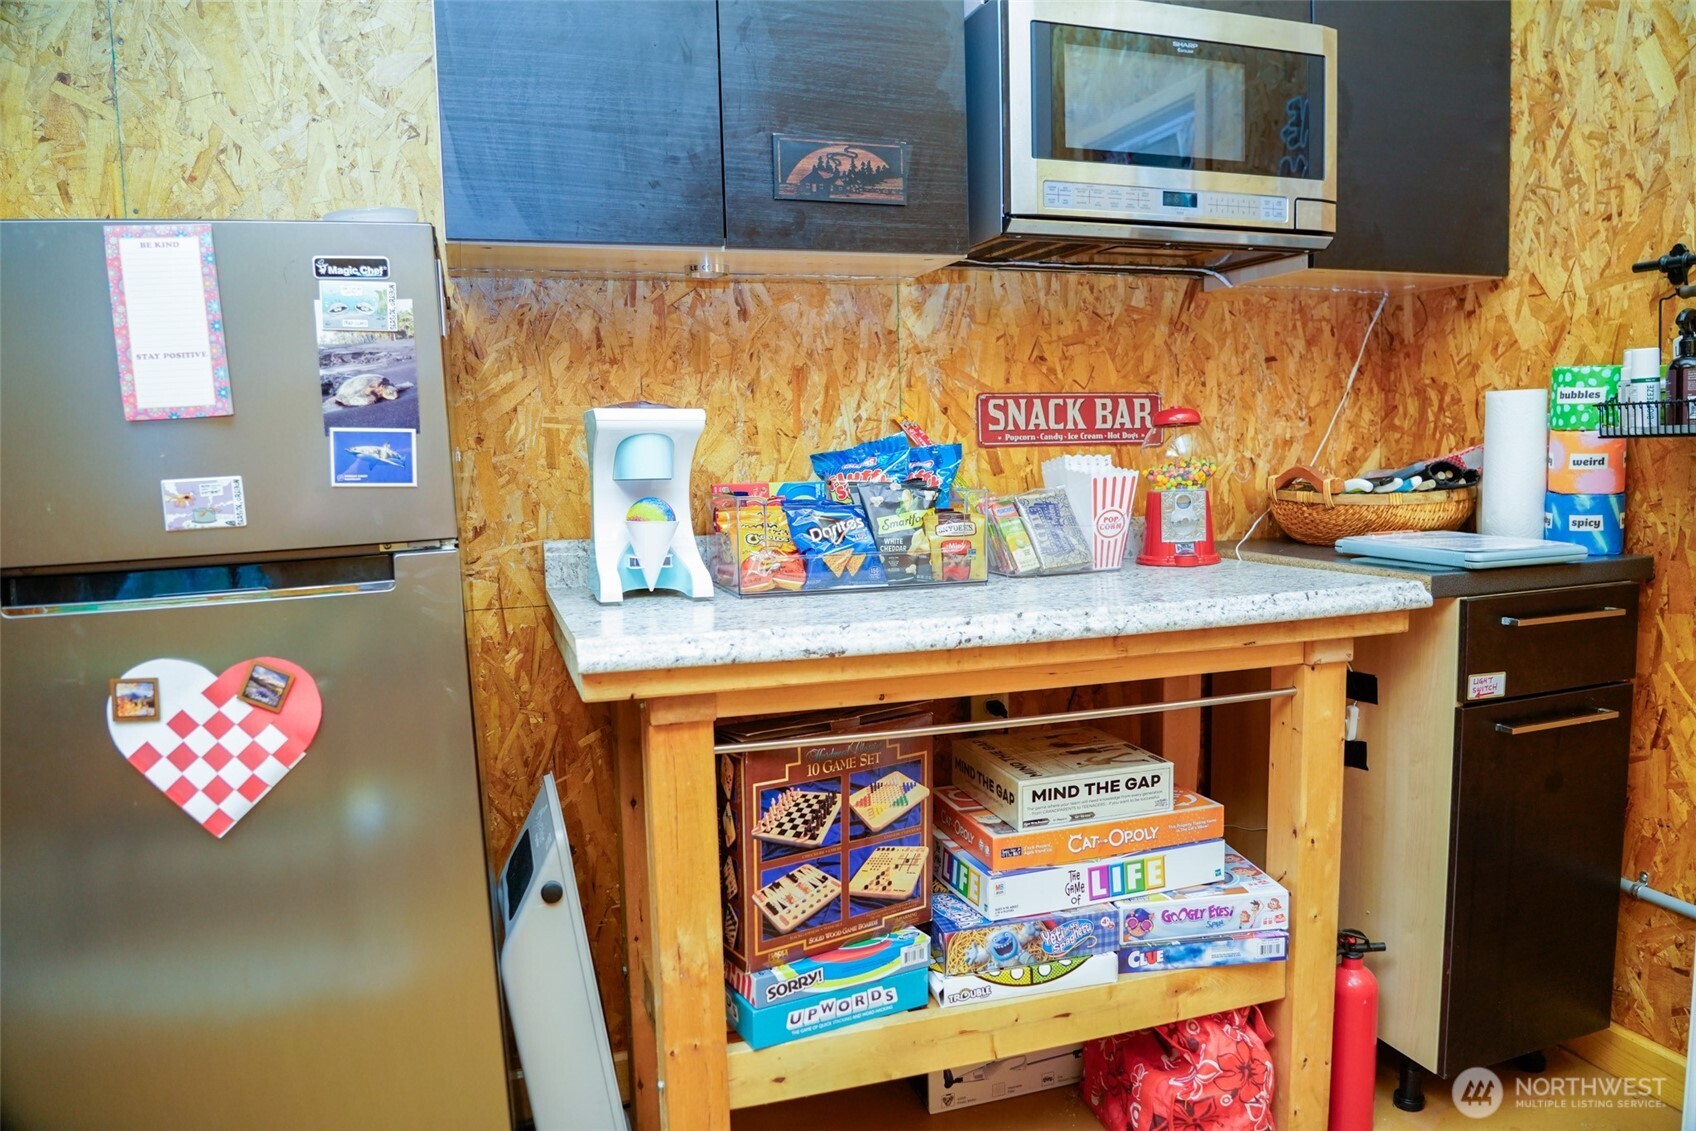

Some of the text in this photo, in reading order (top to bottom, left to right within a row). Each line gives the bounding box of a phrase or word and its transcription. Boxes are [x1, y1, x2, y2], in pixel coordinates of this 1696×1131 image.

[1172, 41, 1199, 49] SHARP
[140, 241, 180, 250] BE KIND
[328, 265, 384, 276] Magic Chef
[136, 351, 208, 361] STAY POSITIVE
[1559, 390, 1601, 401] bubbles
[988, 398, 1153, 431] SNACK BAR
[1005, 433, 1036, 442] Popcorn
[1040, 432, 1063, 441] Candy
[1081, 432, 1104, 440] Cream
[1107, 431, 1120, 439] Hot
[1122, 431, 1139, 441] Dogs
[1572, 457, 1606, 467] weird
[881, 512, 922, 531] Smartfo
[1100, 522, 1121, 531] CORN
[1104, 516, 1119, 524] POP
[1571, 517, 1602, 529] spicy
[809, 517, 865, 546] Doritos
[1472, 683, 1498, 693] SWITCH
[1473, 677, 1494, 685] LIGHT
[807, 752, 882, 777] 10 GAME SET
[954, 757, 1015, 805] MIND THE GAP
[1031, 774, 1161, 803] MIND THE GAP
[943, 850, 979, 903] LIFE
[1089, 857, 1164, 898] LIFE
[1161, 908, 1207, 923] GOOGLY
[808, 935, 825, 945] SOLID
[825, 930, 842, 939] WOOD
[857, 920, 879, 931] BOARDS
[1041, 927, 1064, 945] Yeti
[1053, 923, 1090, 952] Spaghetti
[1128, 949, 1164, 969] CLUE
[767, 969, 823, 1001] SORRY!
[948, 985, 993, 1003] TROUBLE
[790, 990, 895, 1025] UPWORDS
[819, 1022, 832, 1030] QUICK
